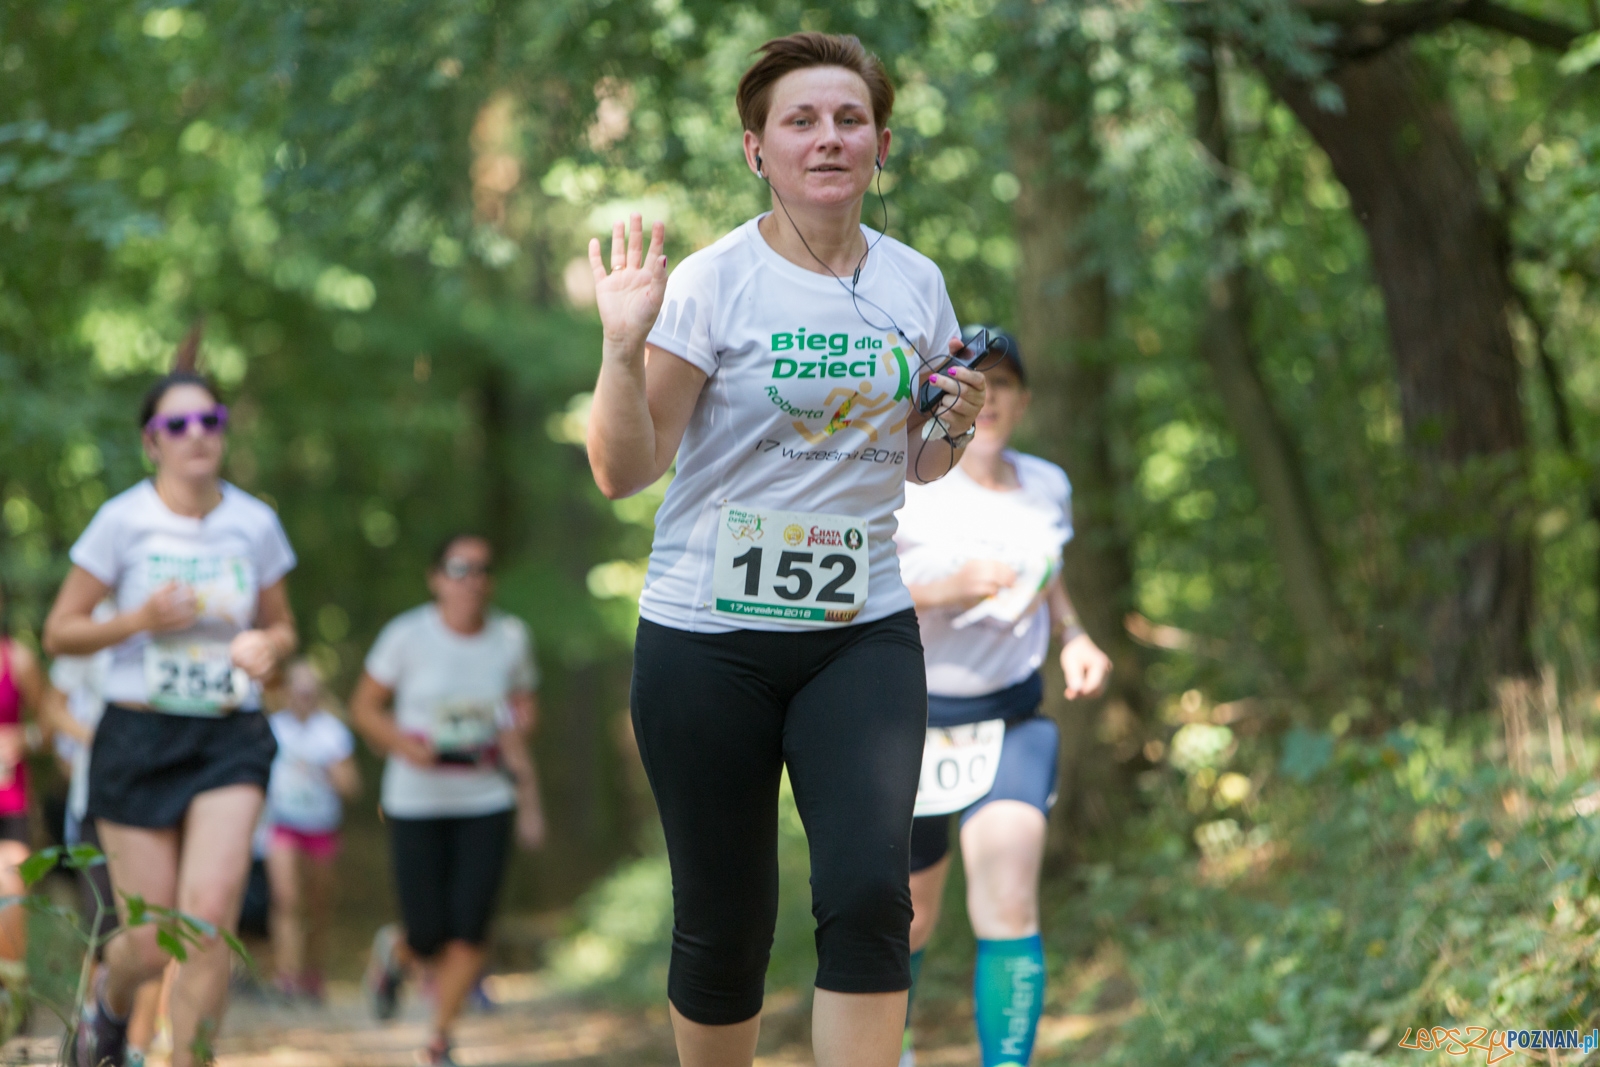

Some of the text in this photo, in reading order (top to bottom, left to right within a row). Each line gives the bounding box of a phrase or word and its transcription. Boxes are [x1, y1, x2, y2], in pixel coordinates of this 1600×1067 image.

[771, 327, 882, 356] Bieg dla
[771, 354, 877, 378] Dzieci
[764, 384, 824, 419] Roberta
[755, 439, 780, 453] 17
[860, 447, 904, 465] 2016
[807, 535, 843, 547] POLSKA
[810, 525, 841, 537] CHATA
[733, 547, 857, 603] 152
[730, 602, 743, 611] 17
[158, 661, 234, 695] 254
